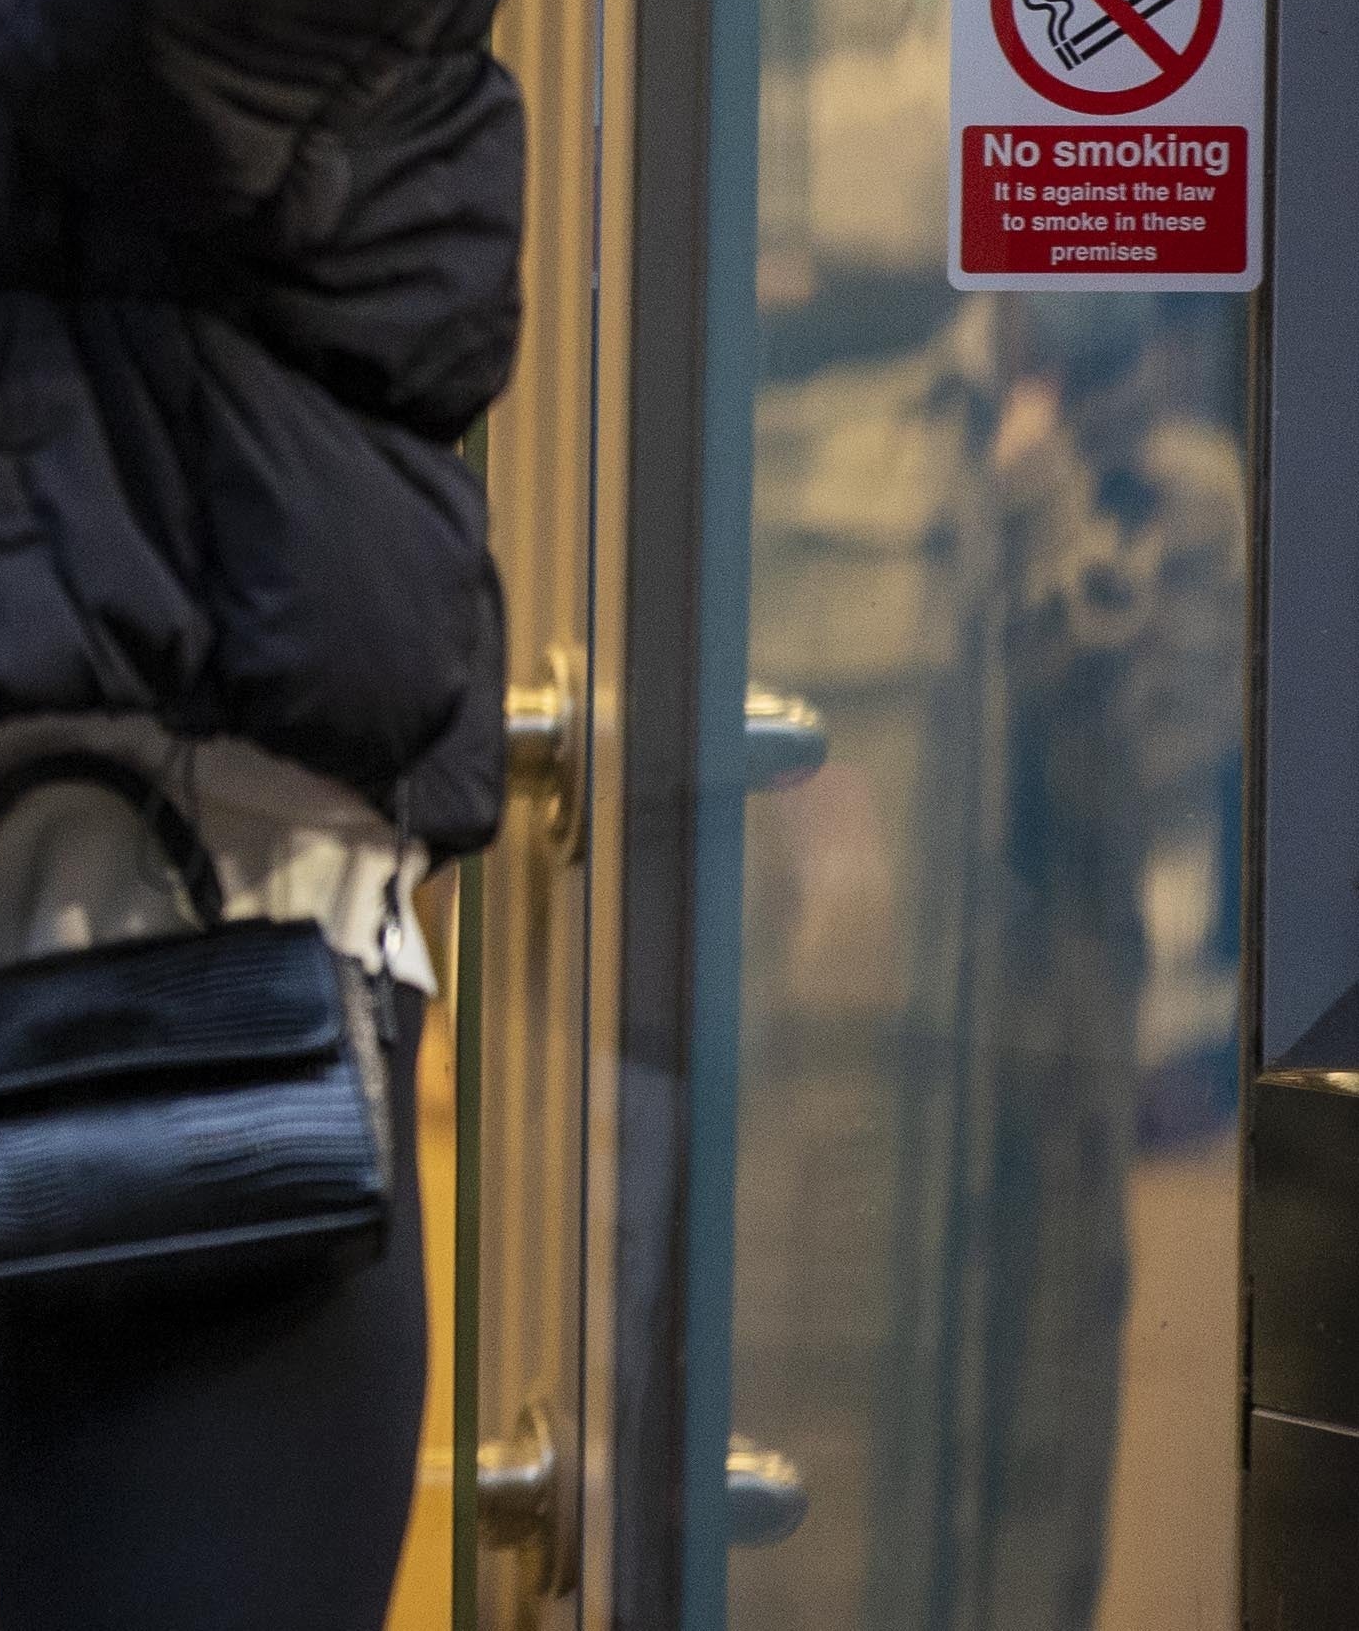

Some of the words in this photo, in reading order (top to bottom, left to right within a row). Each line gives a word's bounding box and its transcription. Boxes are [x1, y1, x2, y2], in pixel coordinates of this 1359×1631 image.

[983, 133, 1041, 168] No
[1052, 132, 1231, 176] smoking
[994, 182, 1010, 202] It
[1016, 182, 1036, 202] is
[1041, 182, 1127, 206] against
[1132, 182, 1170, 202] the
[1176, 182, 1217, 202] law
[1002, 213, 1026, 232] to
[1031, 212, 1108, 232] smoke
[1114, 212, 1136, 232] in
[1141, 212, 1207, 232] these
[1050, 242, 1159, 266] premises
